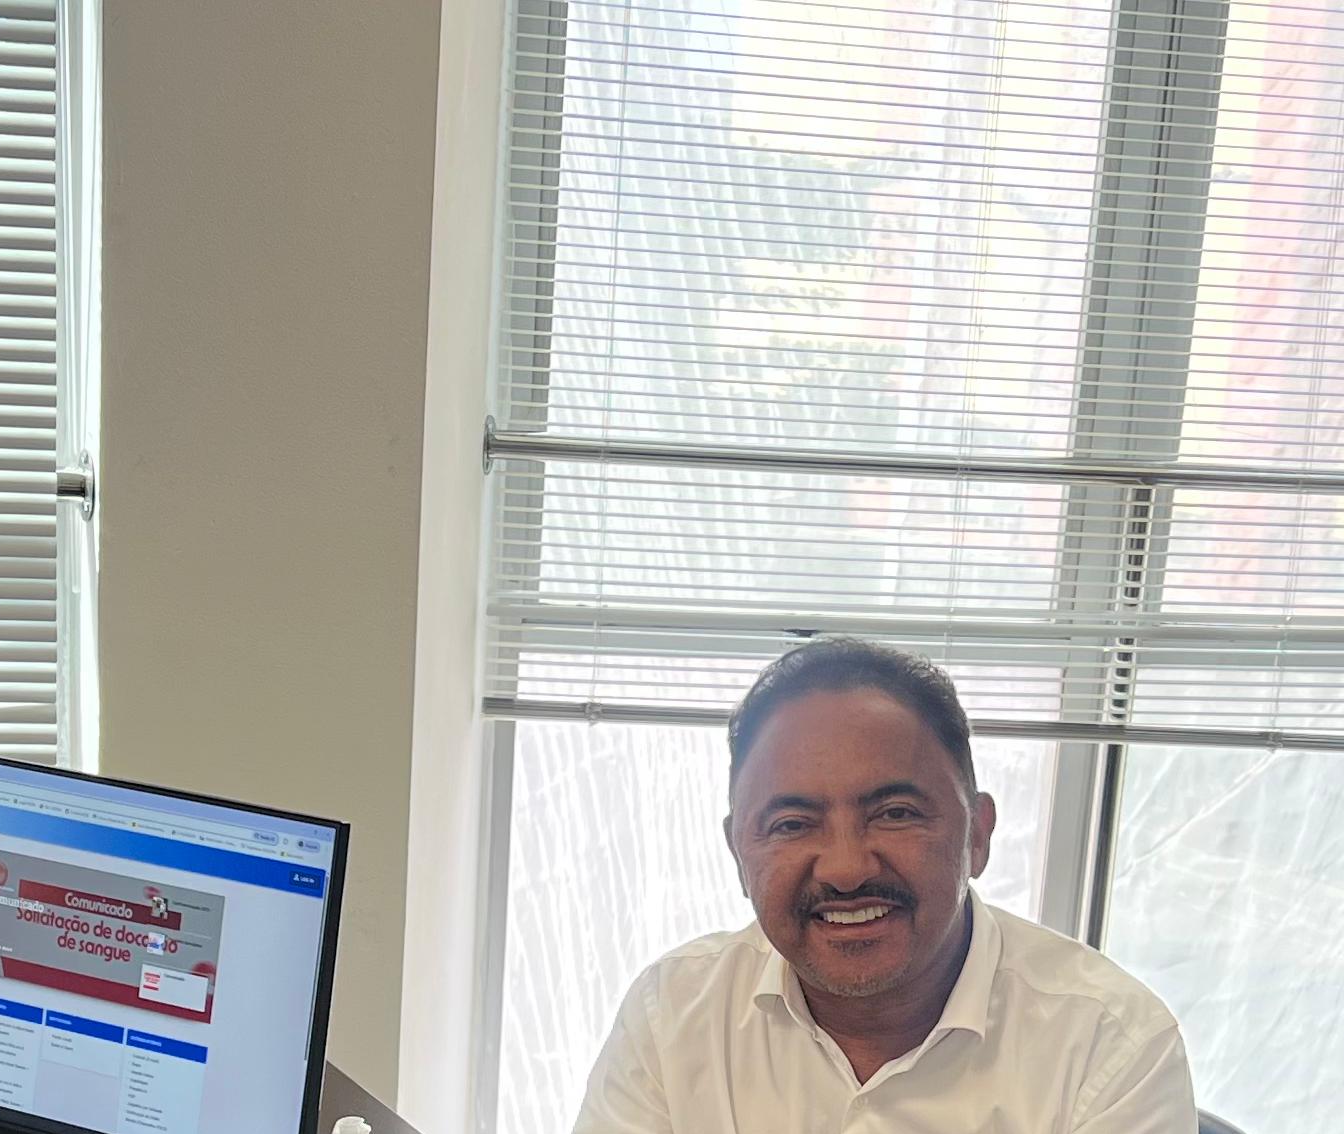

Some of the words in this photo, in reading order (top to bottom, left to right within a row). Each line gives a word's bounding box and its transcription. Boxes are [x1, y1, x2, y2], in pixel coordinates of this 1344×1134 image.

[64, 891, 133, 919] Comunicado
[93, 921, 112, 939] de
[57, 933, 76, 950] de
[79, 938, 131, 962] sangue
